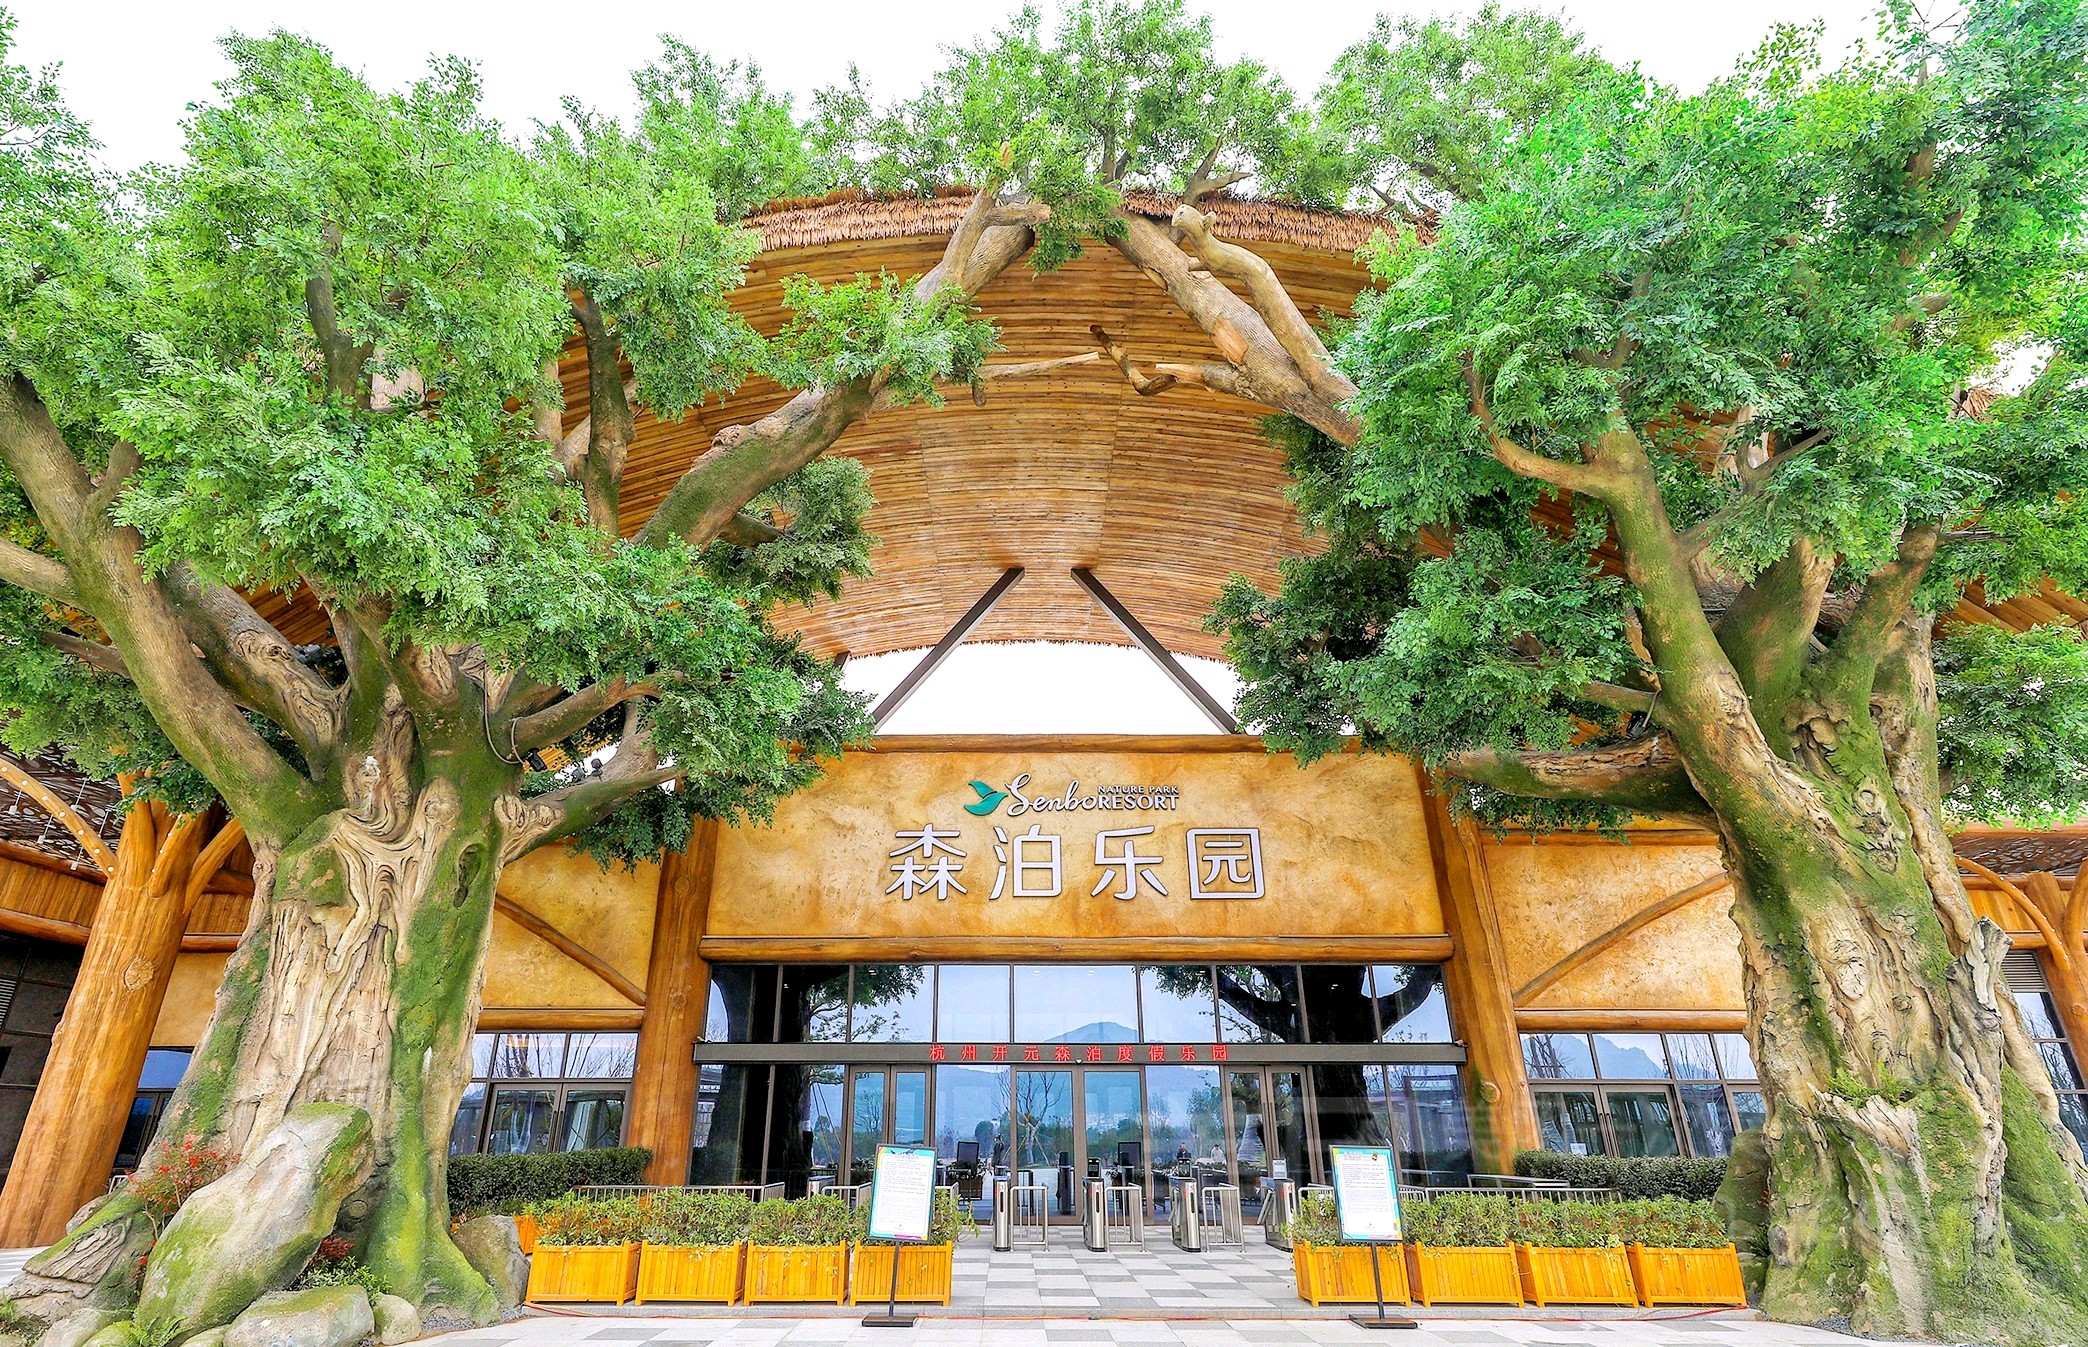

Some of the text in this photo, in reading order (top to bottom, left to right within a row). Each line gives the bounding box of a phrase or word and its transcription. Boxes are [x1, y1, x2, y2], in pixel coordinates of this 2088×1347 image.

[1004, 772, 1179, 817] Senbo RESORT
[1097, 785, 1179, 795] NATURE PARK
[886, 823, 1266, 901] 森泊乐园
[929, 1044, 1229, 1062] 杭州开元森泊度假乐园
